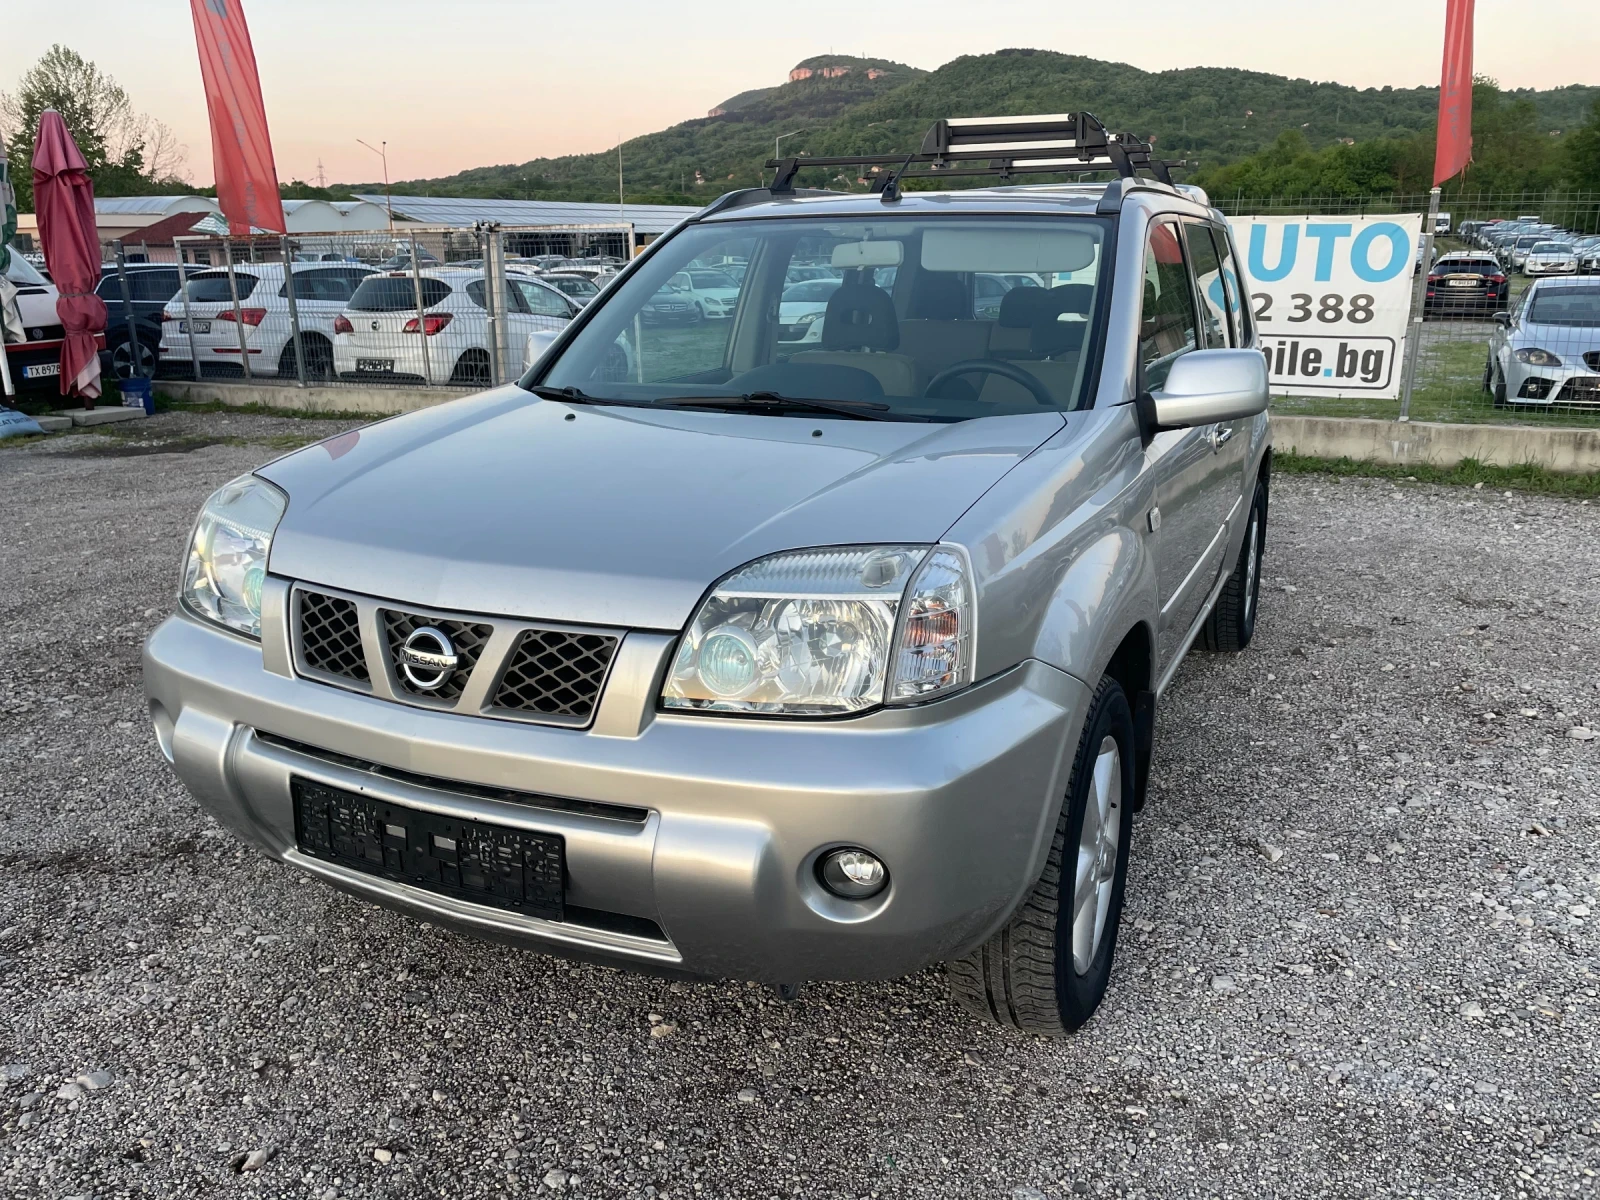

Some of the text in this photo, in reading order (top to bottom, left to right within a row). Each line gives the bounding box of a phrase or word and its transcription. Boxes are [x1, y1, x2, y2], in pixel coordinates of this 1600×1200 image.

[1229, 222, 1410, 283] UTO
[1287, 293, 1375, 324] 388
[28, 366, 40, 376] TX
[401, 651, 448, 668] NISSAN
